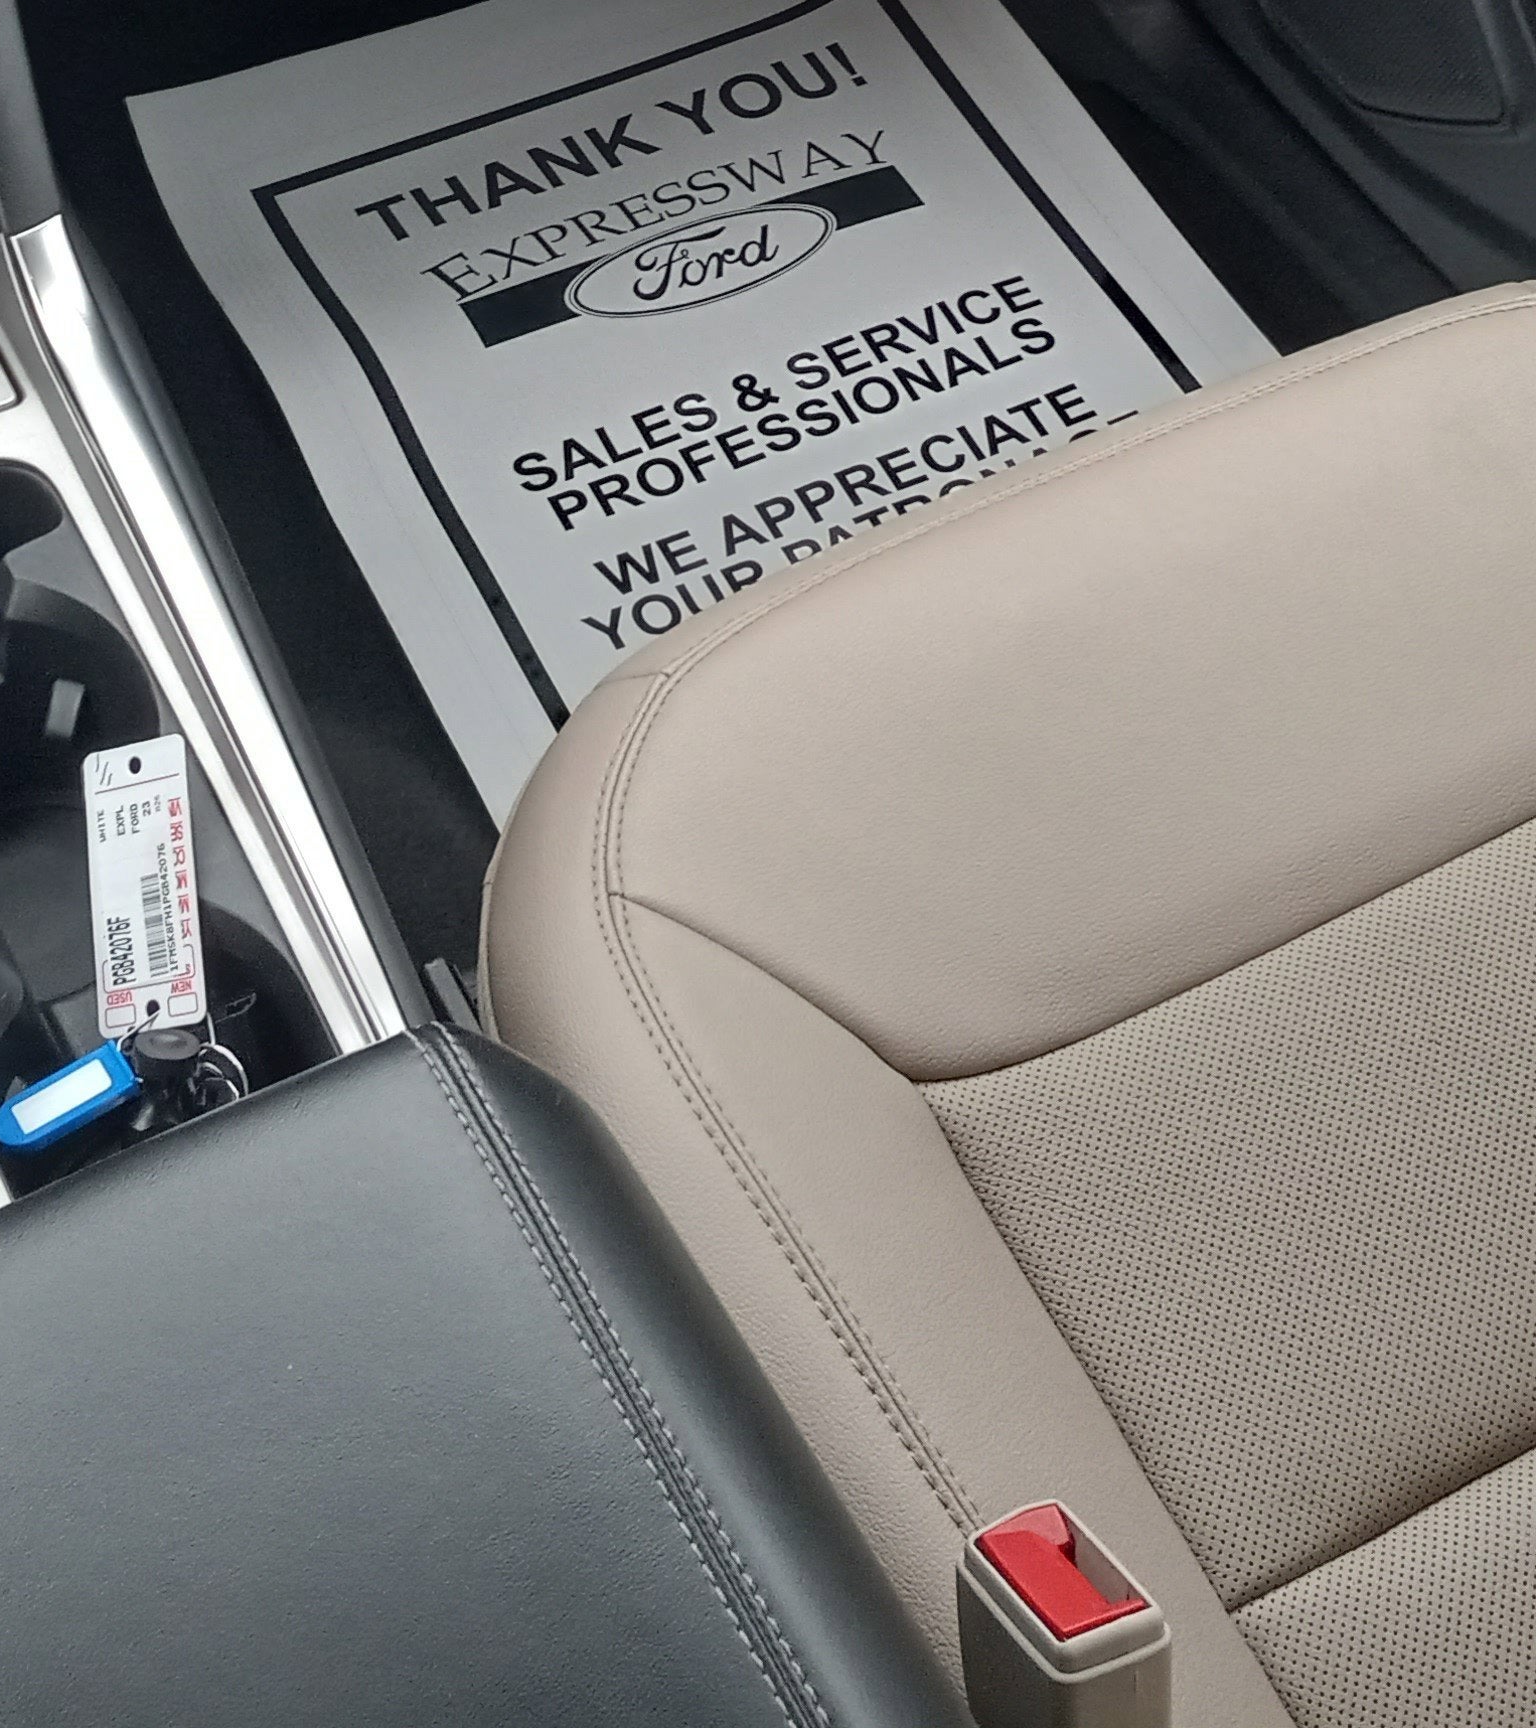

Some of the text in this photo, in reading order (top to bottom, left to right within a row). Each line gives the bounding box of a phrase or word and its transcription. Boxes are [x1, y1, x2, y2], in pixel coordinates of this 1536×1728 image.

[354, 42, 868, 242] THANK YOU!
[420, 129, 891, 302] EXPRESSWAY
[631, 224, 781, 302] Ford
[512, 391, 718, 494] SALES
[731, 373, 781, 413] &
[785, 275, 1044, 392] SERVICE
[546, 317, 1057, 532] PROFESSIONALS
[593, 530, 709, 597] WE
[721, 383, 1098, 557] APPRECIATE
[96, 808, 107, 843] WHITE
[115, 805, 126, 837] EXPL
[129, 803, 140, 834] FORD
[142, 800, 152, 817] 23
[106, 916, 137, 986] PGB42076F
[106, 991, 133, 1006] USED
[170, 979, 193, 994] NEW
